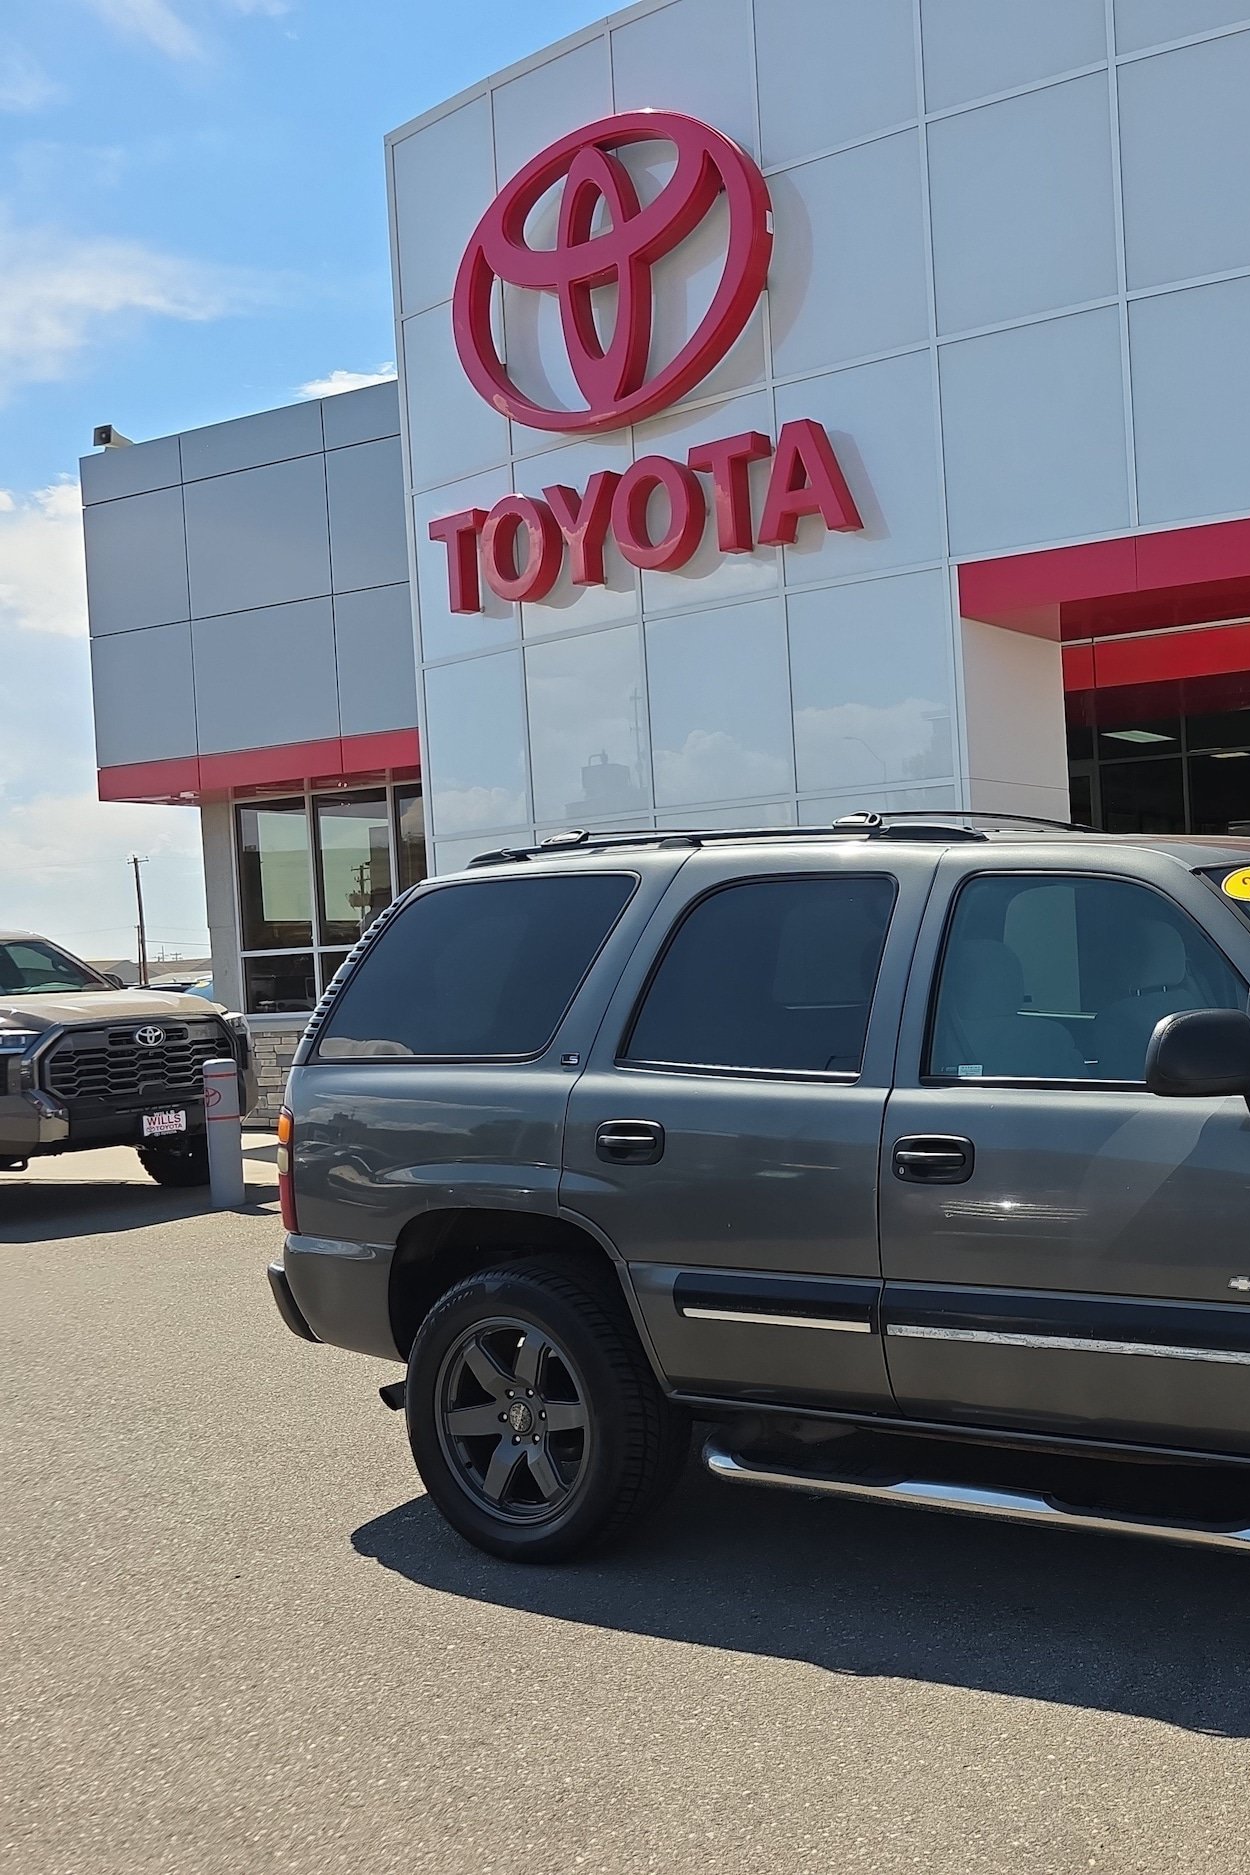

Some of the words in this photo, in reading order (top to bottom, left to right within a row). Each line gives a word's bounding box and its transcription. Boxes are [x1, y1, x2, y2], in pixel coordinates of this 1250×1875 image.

[428, 418, 864, 614] TOYOTA
[561, 1055, 578, 1064] LS
[147, 1114, 181, 1126] WILLS
